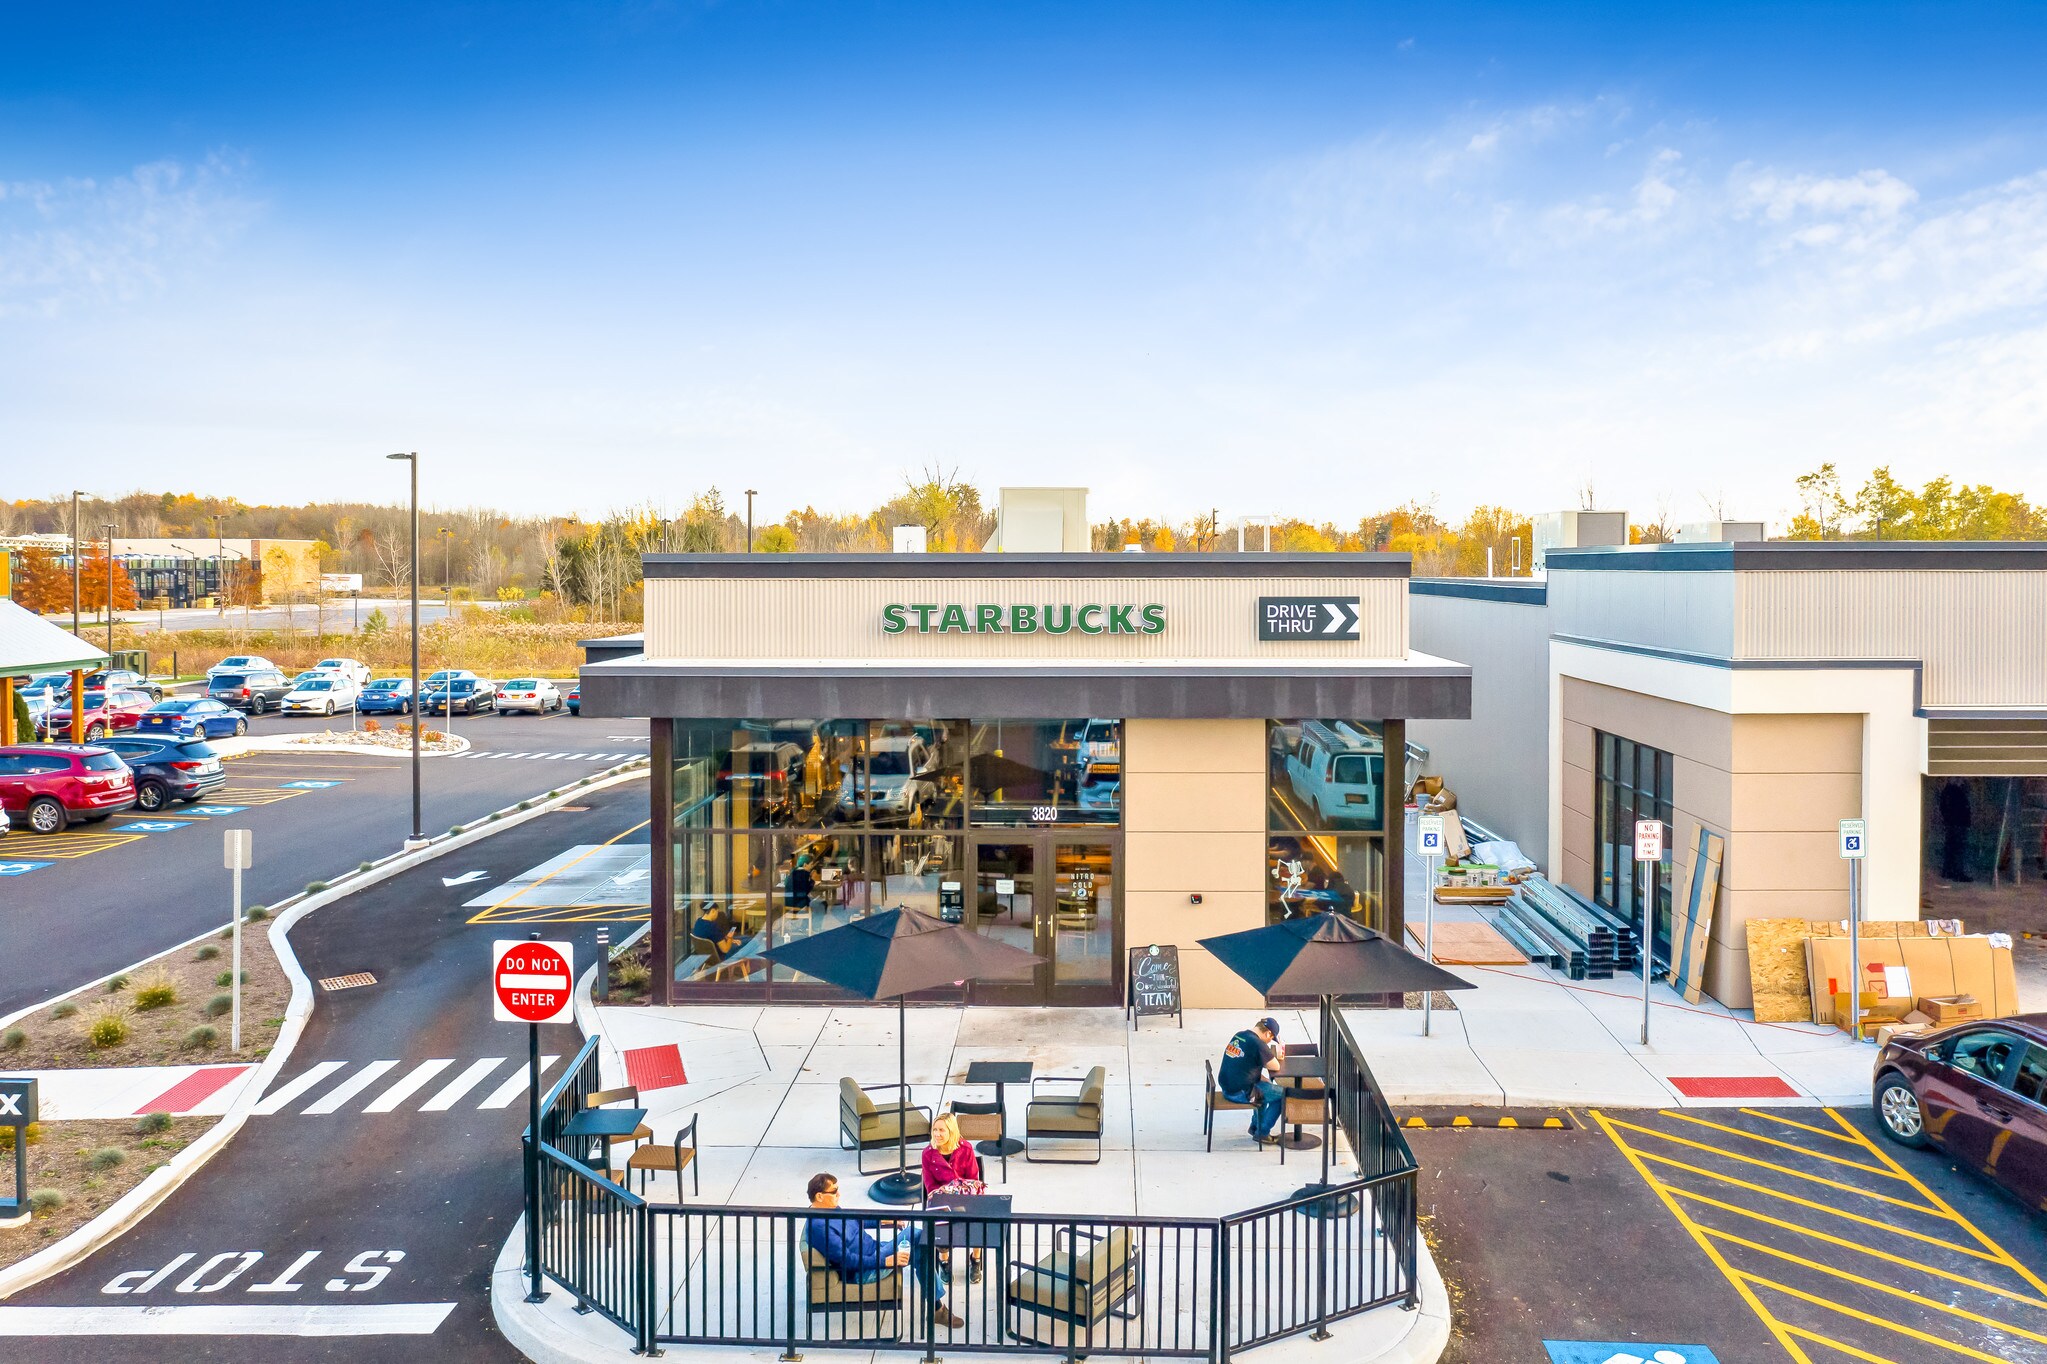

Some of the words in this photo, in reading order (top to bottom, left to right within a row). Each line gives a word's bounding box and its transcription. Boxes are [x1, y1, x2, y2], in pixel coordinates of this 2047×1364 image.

[1266, 604, 1317, 618] DRIVE
[882, 603, 1166, 634] STARBUCKS
[1266, 619, 1313, 633] THRU
[1032, 806, 1058, 821] 3820
[1644, 824, 1654, 832] NO
[1638, 832, 1659, 840] PARKING
[1070, 872, 1095, 880] NITRO
[1072, 881, 1093, 889] COLD
[506, 957, 525, 970] DO
[531, 958, 560, 971] NOT
[511, 992, 555, 1007] ENTER
[1141, 992, 1172, 1006] TEAM
[100, 1250, 407, 1295] STOP
